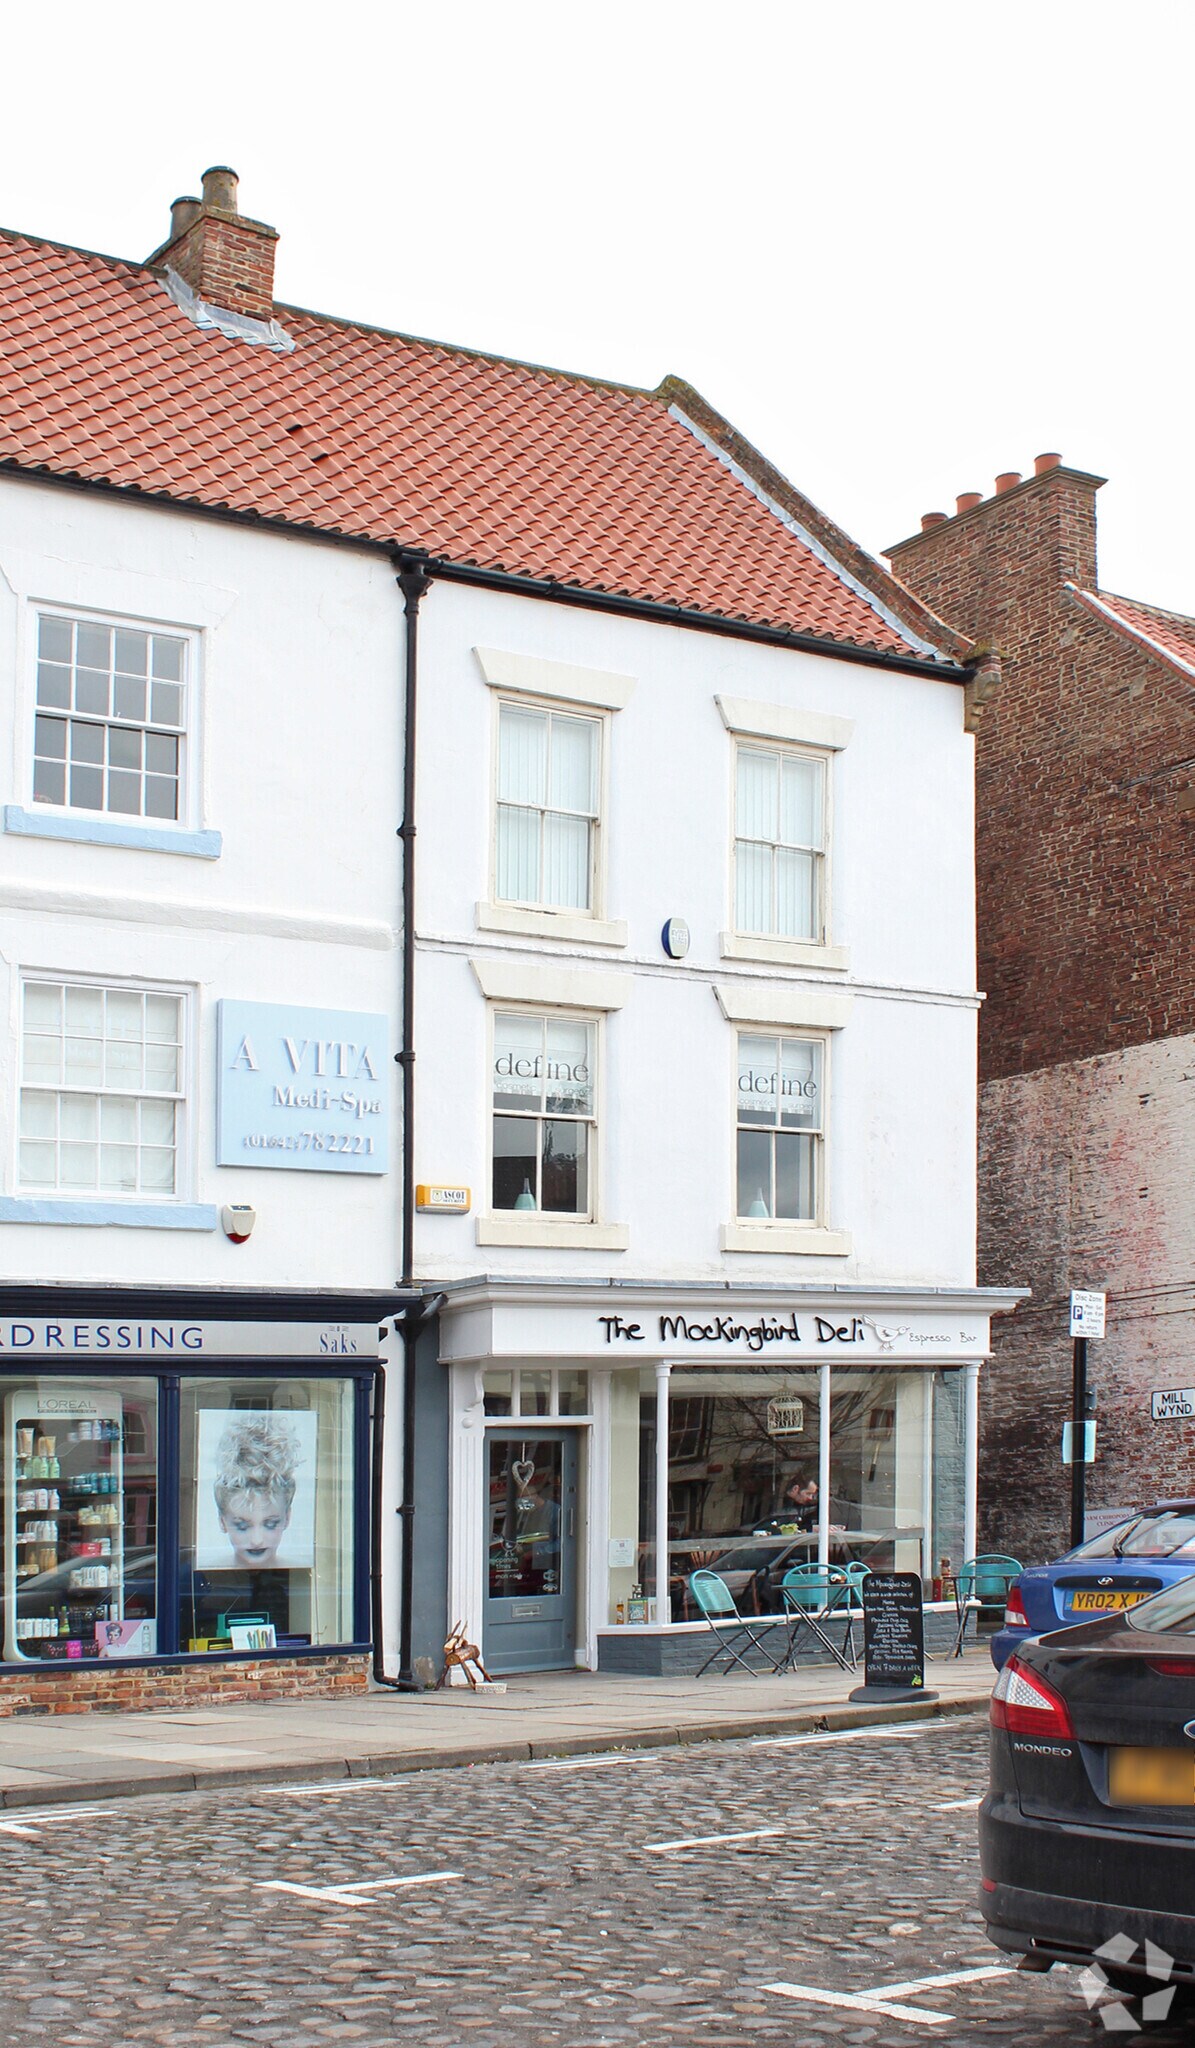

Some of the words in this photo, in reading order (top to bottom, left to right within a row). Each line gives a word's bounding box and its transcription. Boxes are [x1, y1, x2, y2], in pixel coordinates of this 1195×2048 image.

[229, 1033, 260, 1071] A
[282, 1036, 379, 1080] VITA
[495, 1053, 589, 1082] define
[738, 1071, 817, 1098] define
[273, 1085, 382, 1119] Medi-Spa
[0, 1324, 203, 1349] DRESSING
[598, 1315, 645, 1343] The
[814, 1316, 864, 1343] Deli
[909, 1332, 952, 1345] Espresso
[959, 1331, 978, 1344] Bar
[320, 1332, 357, 1353] Saks
[1161, 1392, 1187, 1404] MILL
[1157, 1404, 1193, 1417] WYND
[1076, 1593, 1115, 1609] YR02
[1014, 1743, 1072, 1757] MONDEO
